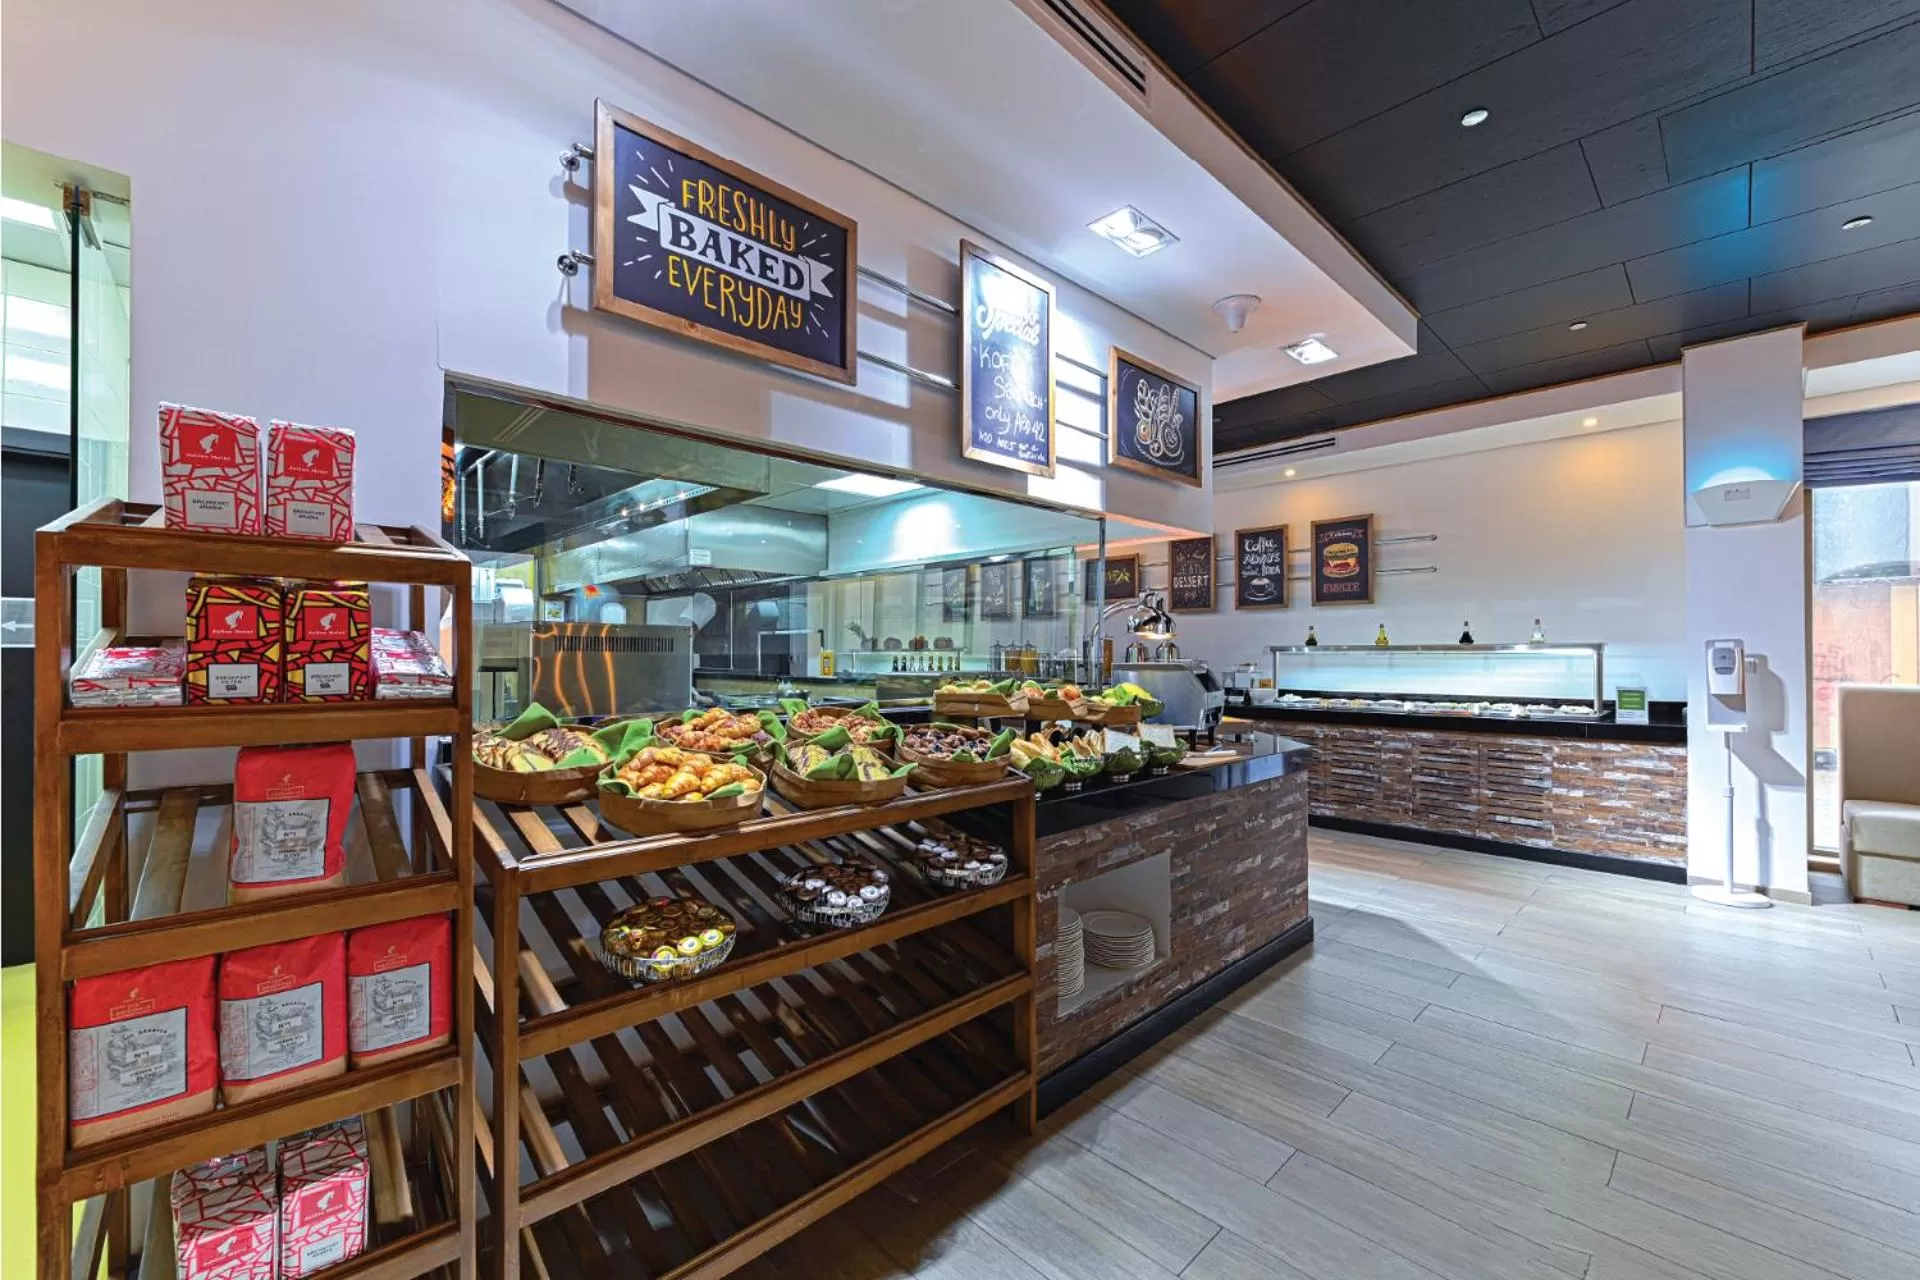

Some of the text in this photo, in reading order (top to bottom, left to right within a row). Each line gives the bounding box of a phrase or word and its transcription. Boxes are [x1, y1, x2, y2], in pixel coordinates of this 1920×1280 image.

[681, 179, 796, 251] FRESHLY
[669, 213, 805, 292] BAKED
[668, 255, 804, 331] EVERYDAY
[1173, 575, 1208, 589] DESSERT
